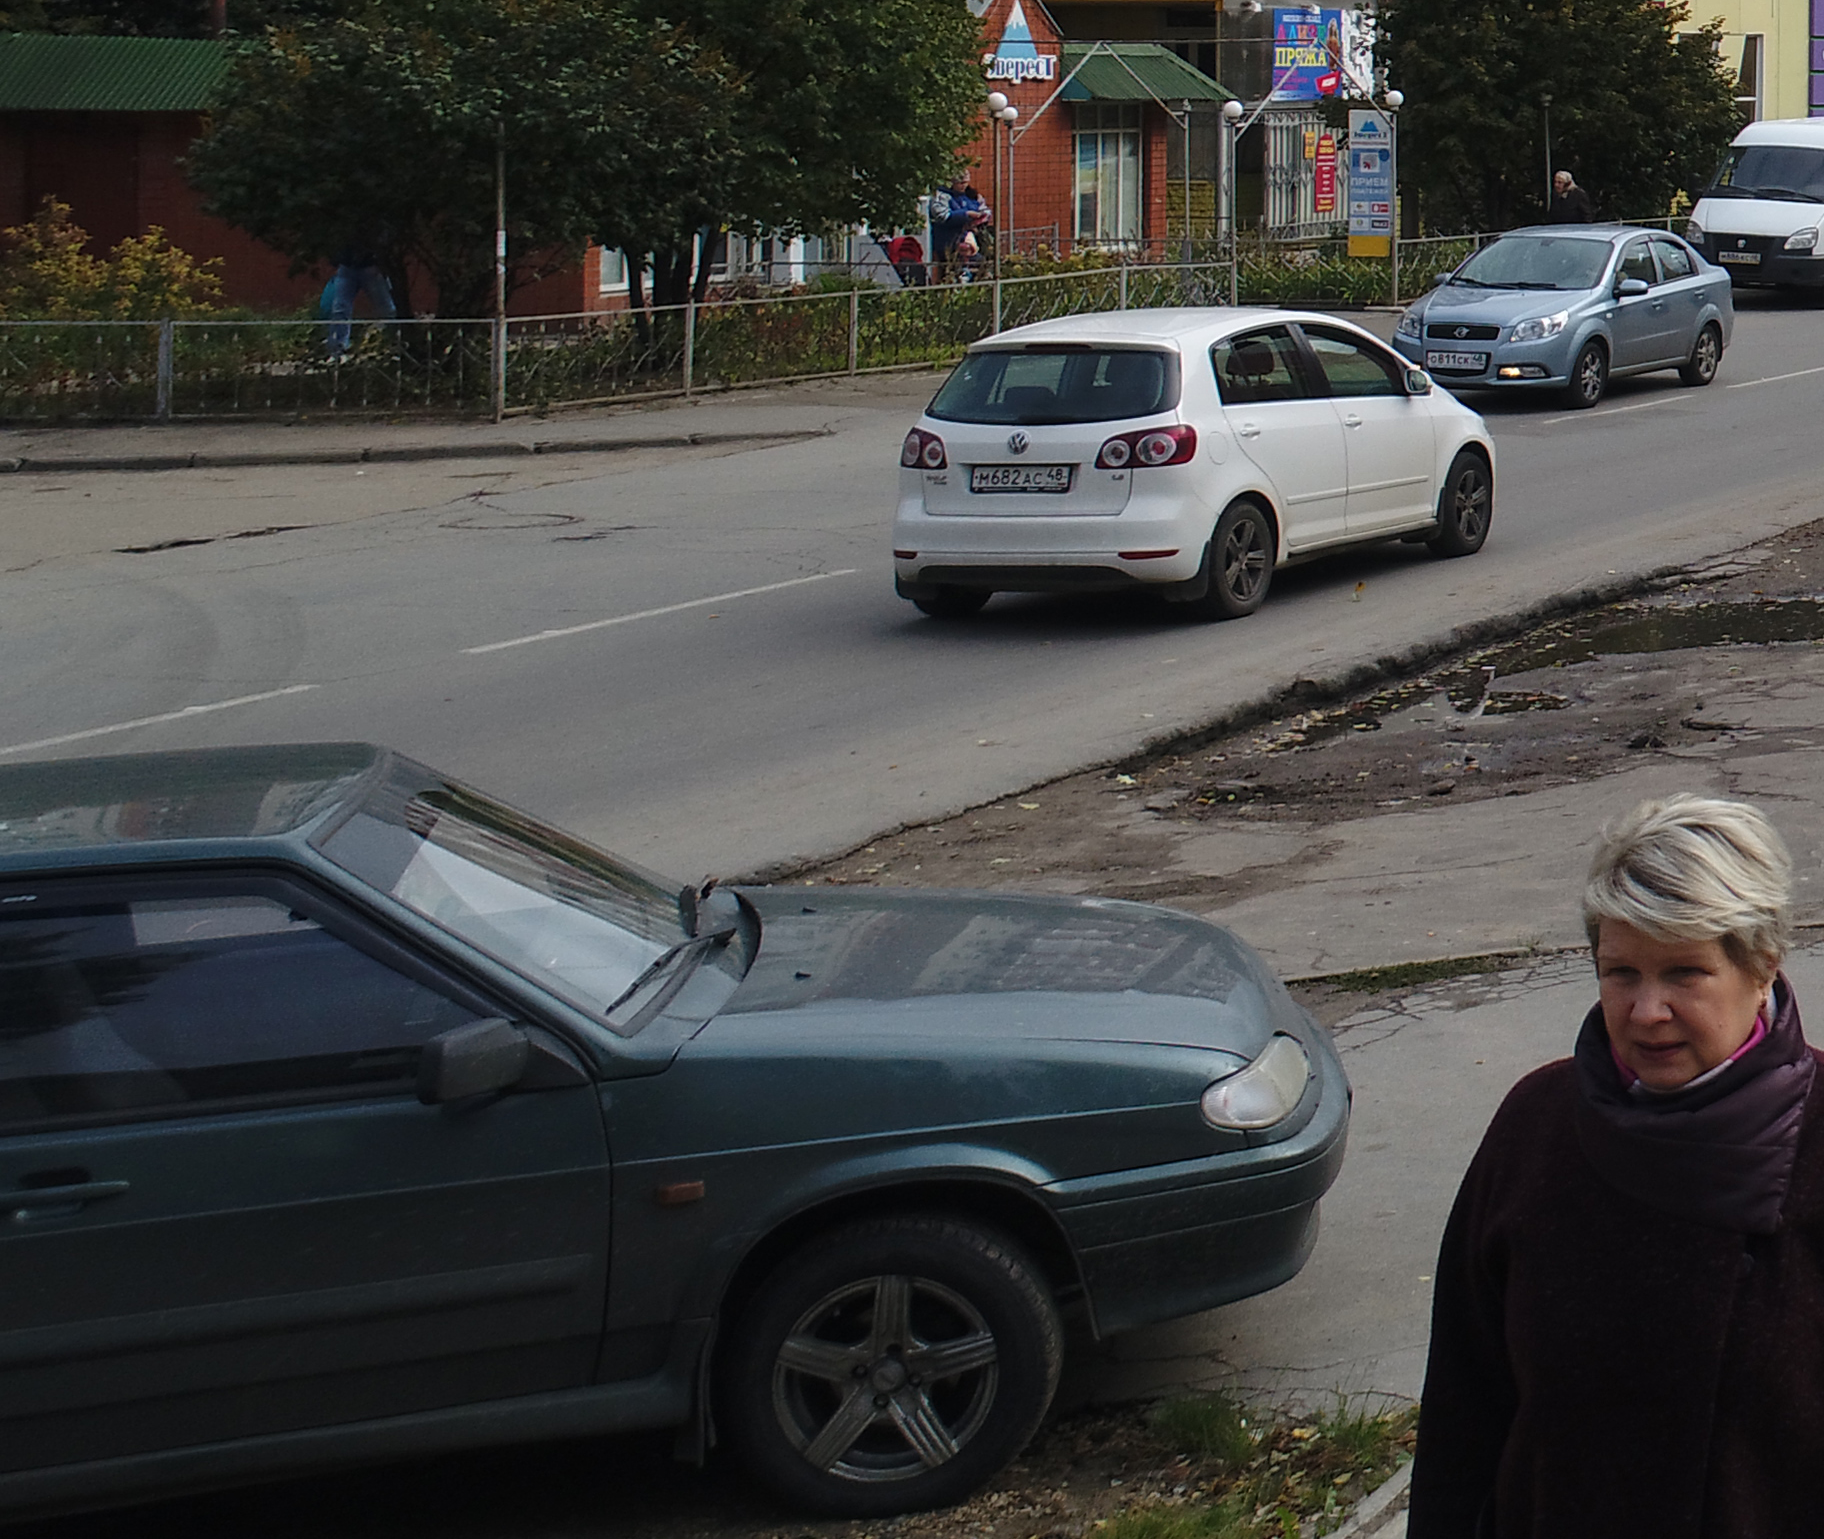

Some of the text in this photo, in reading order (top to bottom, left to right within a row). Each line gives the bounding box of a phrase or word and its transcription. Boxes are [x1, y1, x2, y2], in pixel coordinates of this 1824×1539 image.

[1275, 47, 1327, 67] ПРЯЖА
[979, 468, 1063, 486] М682АС 48
